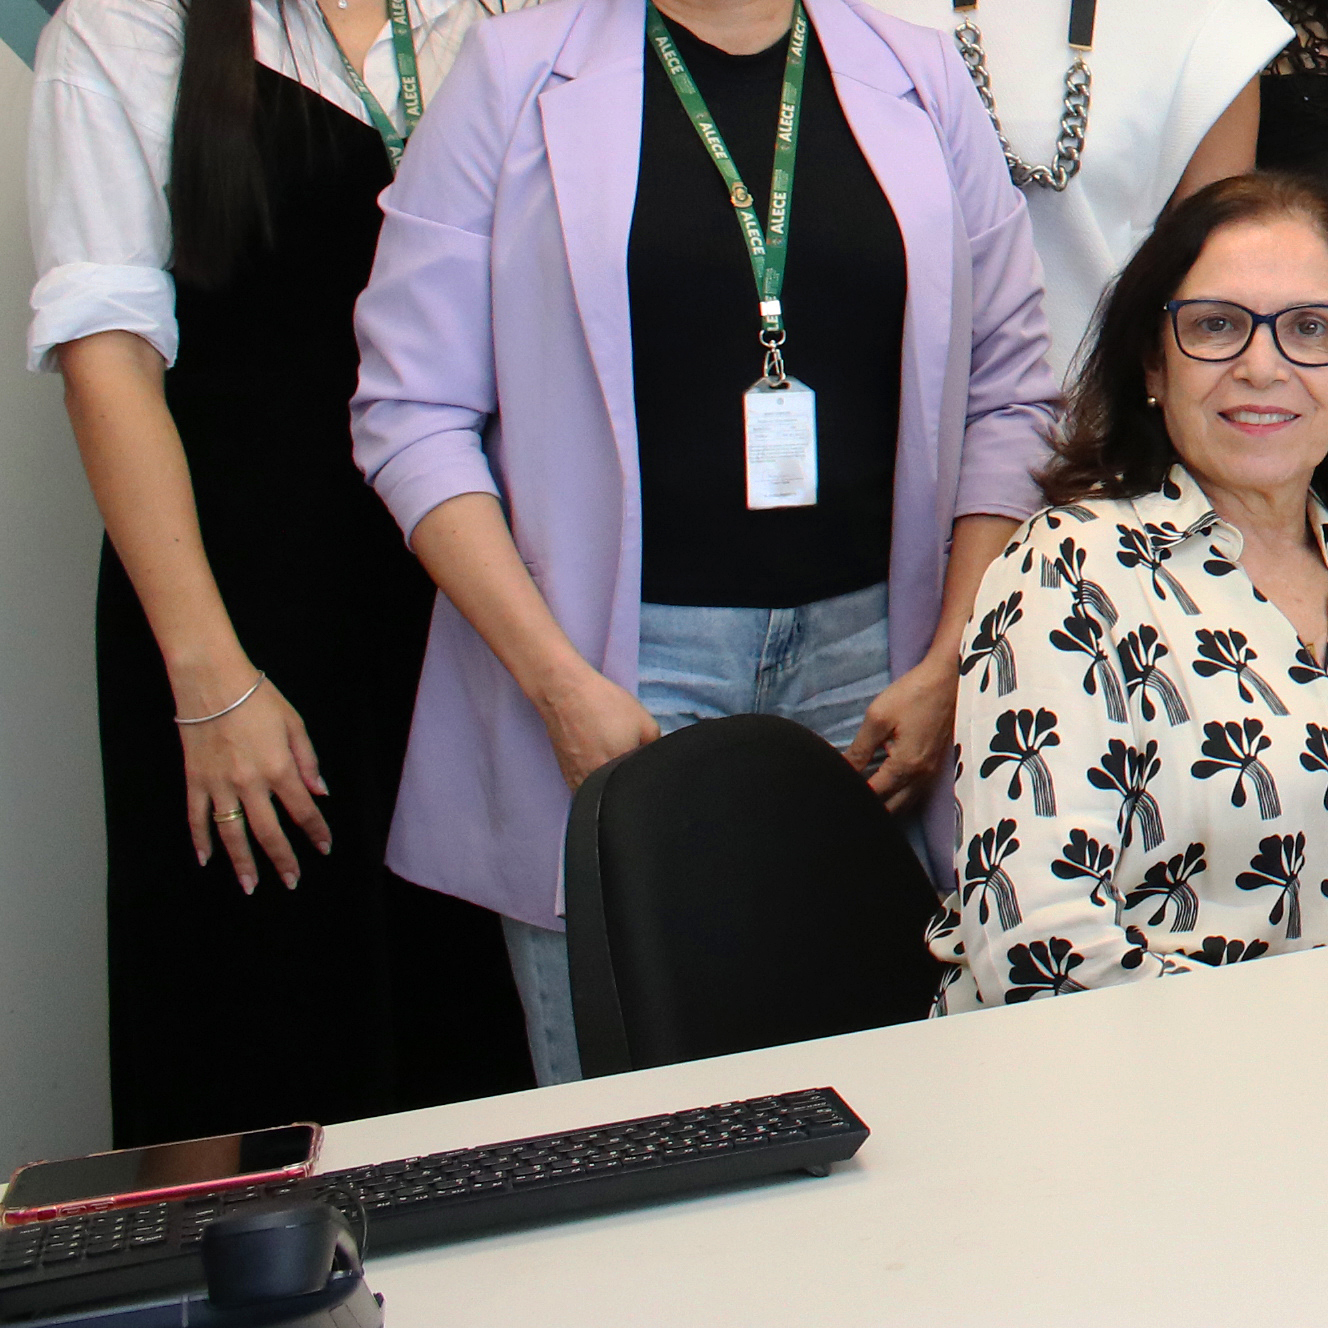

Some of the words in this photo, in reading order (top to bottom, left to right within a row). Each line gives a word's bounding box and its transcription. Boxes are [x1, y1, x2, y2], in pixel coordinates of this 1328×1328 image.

[655, 35, 684, 75] ALECE
[792, 17, 807, 58] ALECE
[402, 76, 421, 116] ALECE
[699, 122, 728, 160] ALECE
[780, 102, 795, 143] ALECE
[740, 210, 766, 257] ALECE
[770, 191, 786, 235] ALECE
